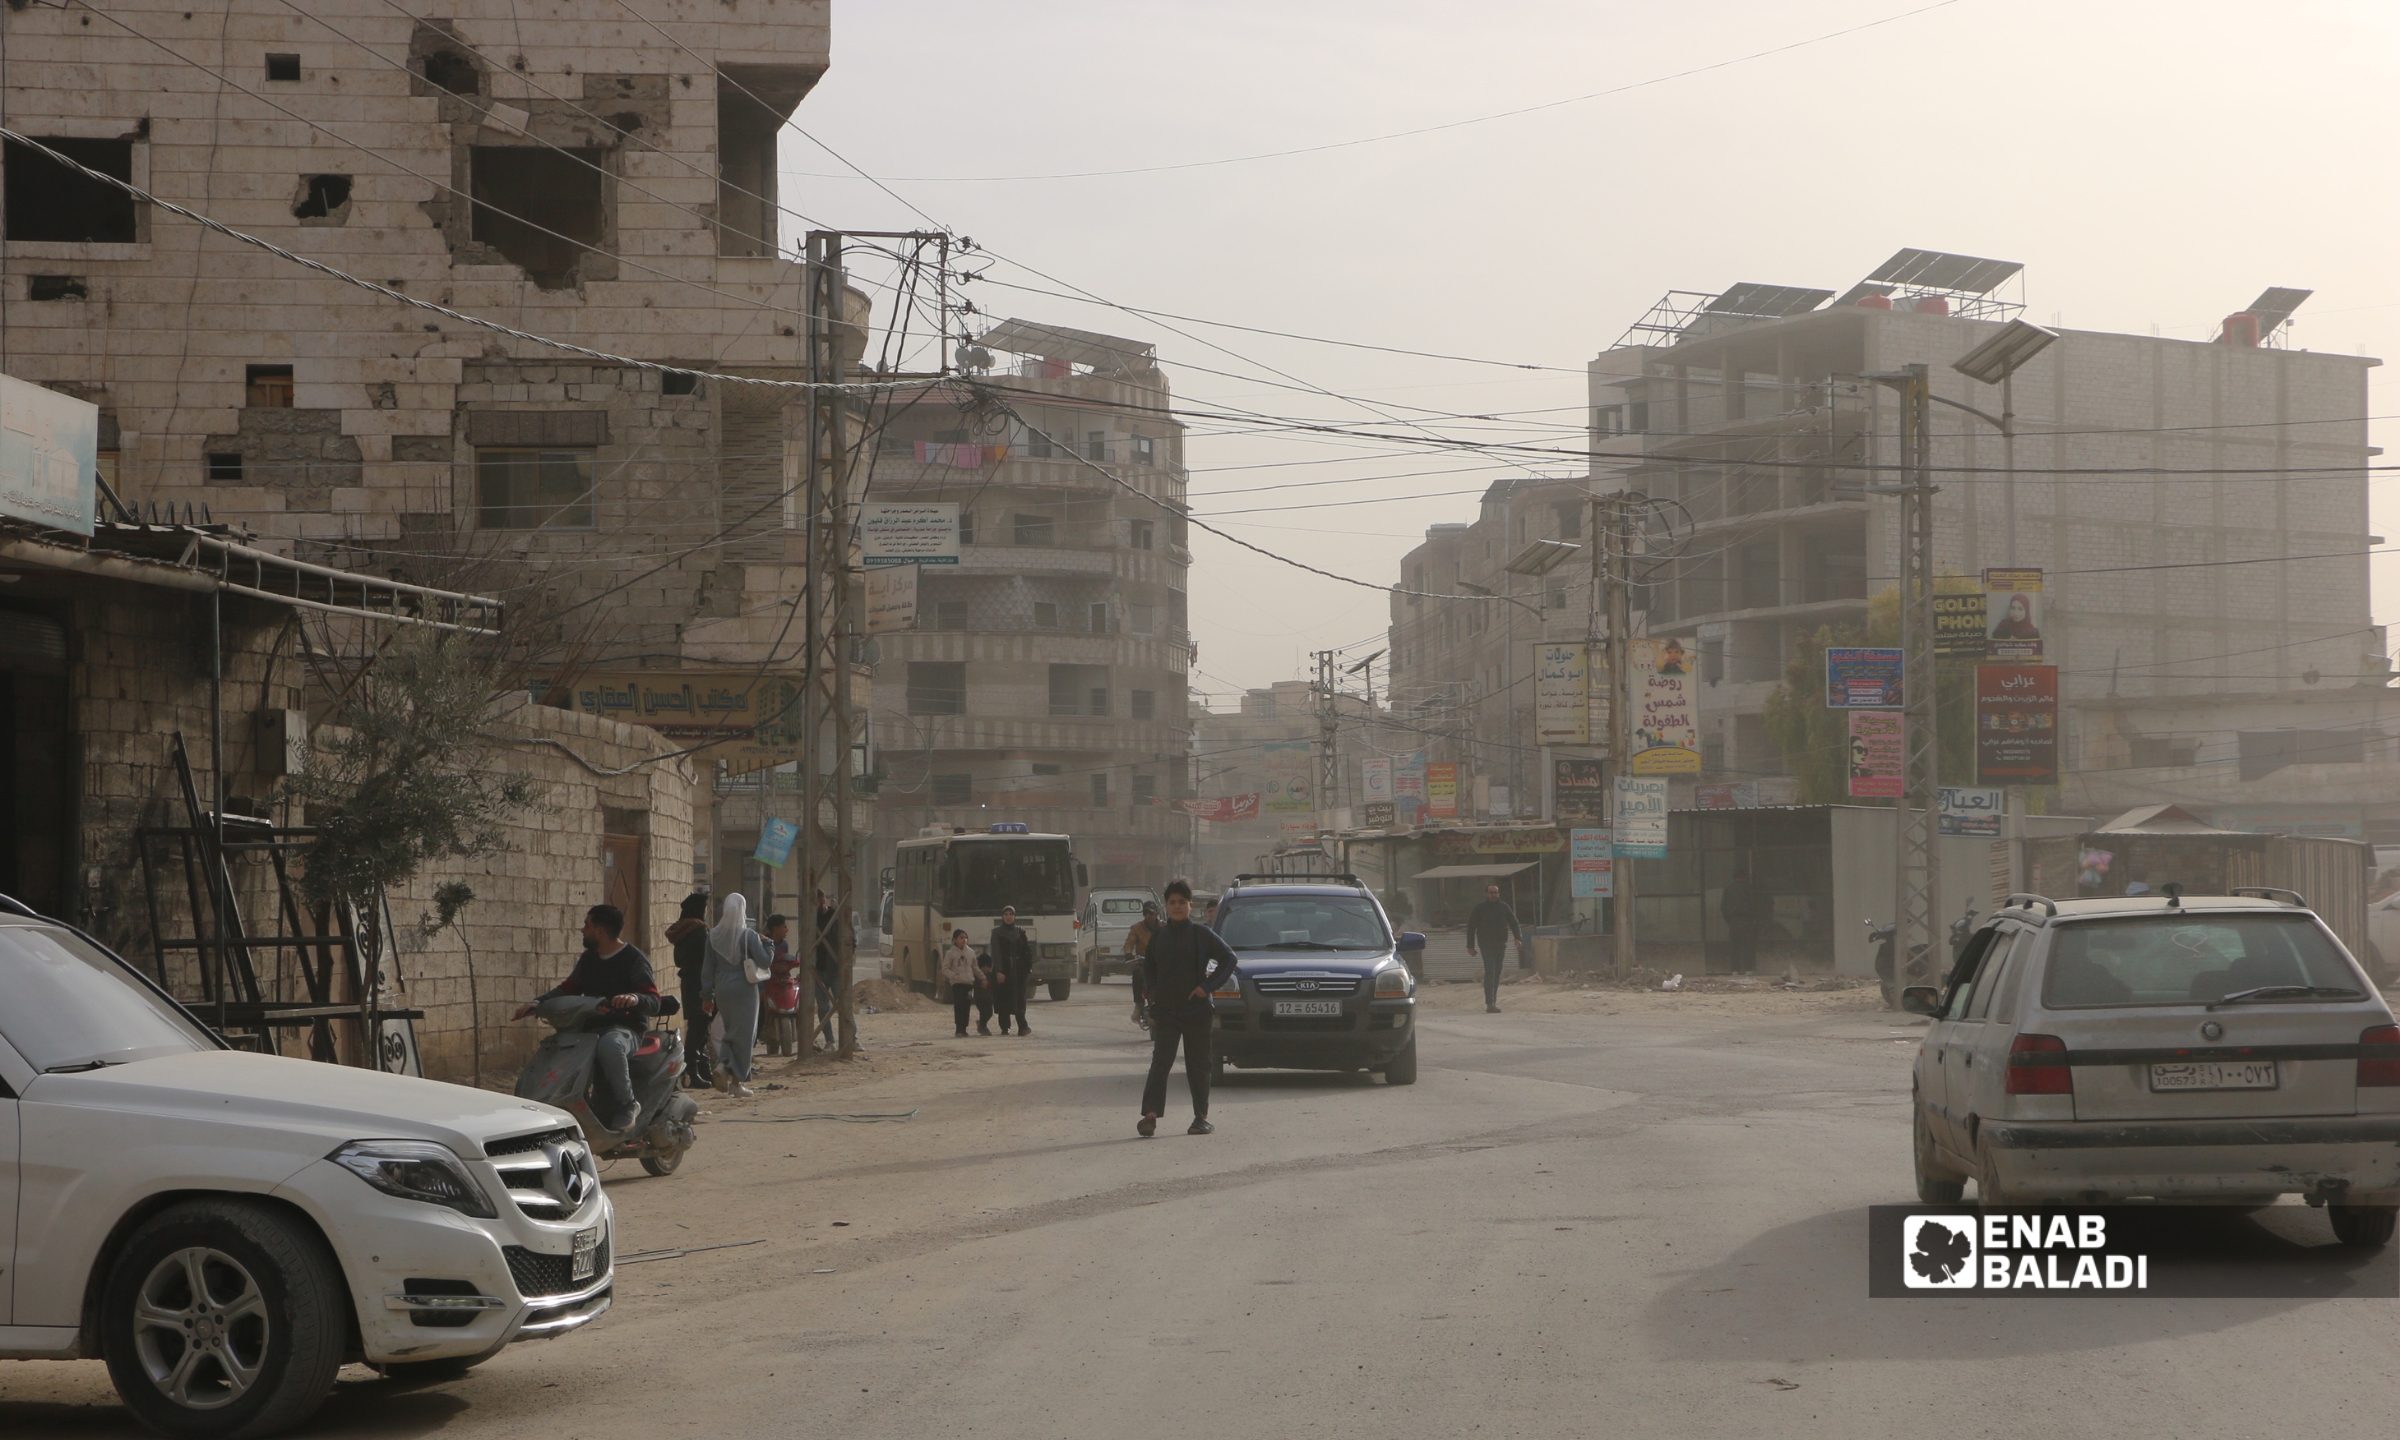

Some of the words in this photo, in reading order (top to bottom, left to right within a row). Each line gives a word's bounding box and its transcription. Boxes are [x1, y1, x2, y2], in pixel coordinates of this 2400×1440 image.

[891, 576, 913, 595] مركز
[1934, 597, 1987, 613] GOLDE
[1937, 615, 1987, 630] PHON
[1546, 649, 1576, 666] حلويات
[1538, 667, 1565, 682] كمال
[1648, 675, 1682, 691] روضة
[2002, 674, 2036, 690] عرابي
[579, 683, 640, 718] العقاري
[643, 684, 694, 717] الحسن
[696, 688, 749, 717] مكتب
[1646, 693, 1687, 713] شمس
[2013, 695, 2037, 704] الزيوت
[2039, 695, 2054, 703] عالم
[1642, 714, 1691, 731] الطفولة
[1558, 773, 1601, 787] لمسات
[1618, 779, 1665, 796] بصريات
[1618, 795, 1663, 816] الأمير
[1943, 790, 2000, 813] العبار
[1478, 832, 1511, 849] لكرم
[1279, 1003, 1292, 1014] 12
[1305, 1003, 1337, 1014] 65416
[2157, 1076, 2197, 1086] 100573
